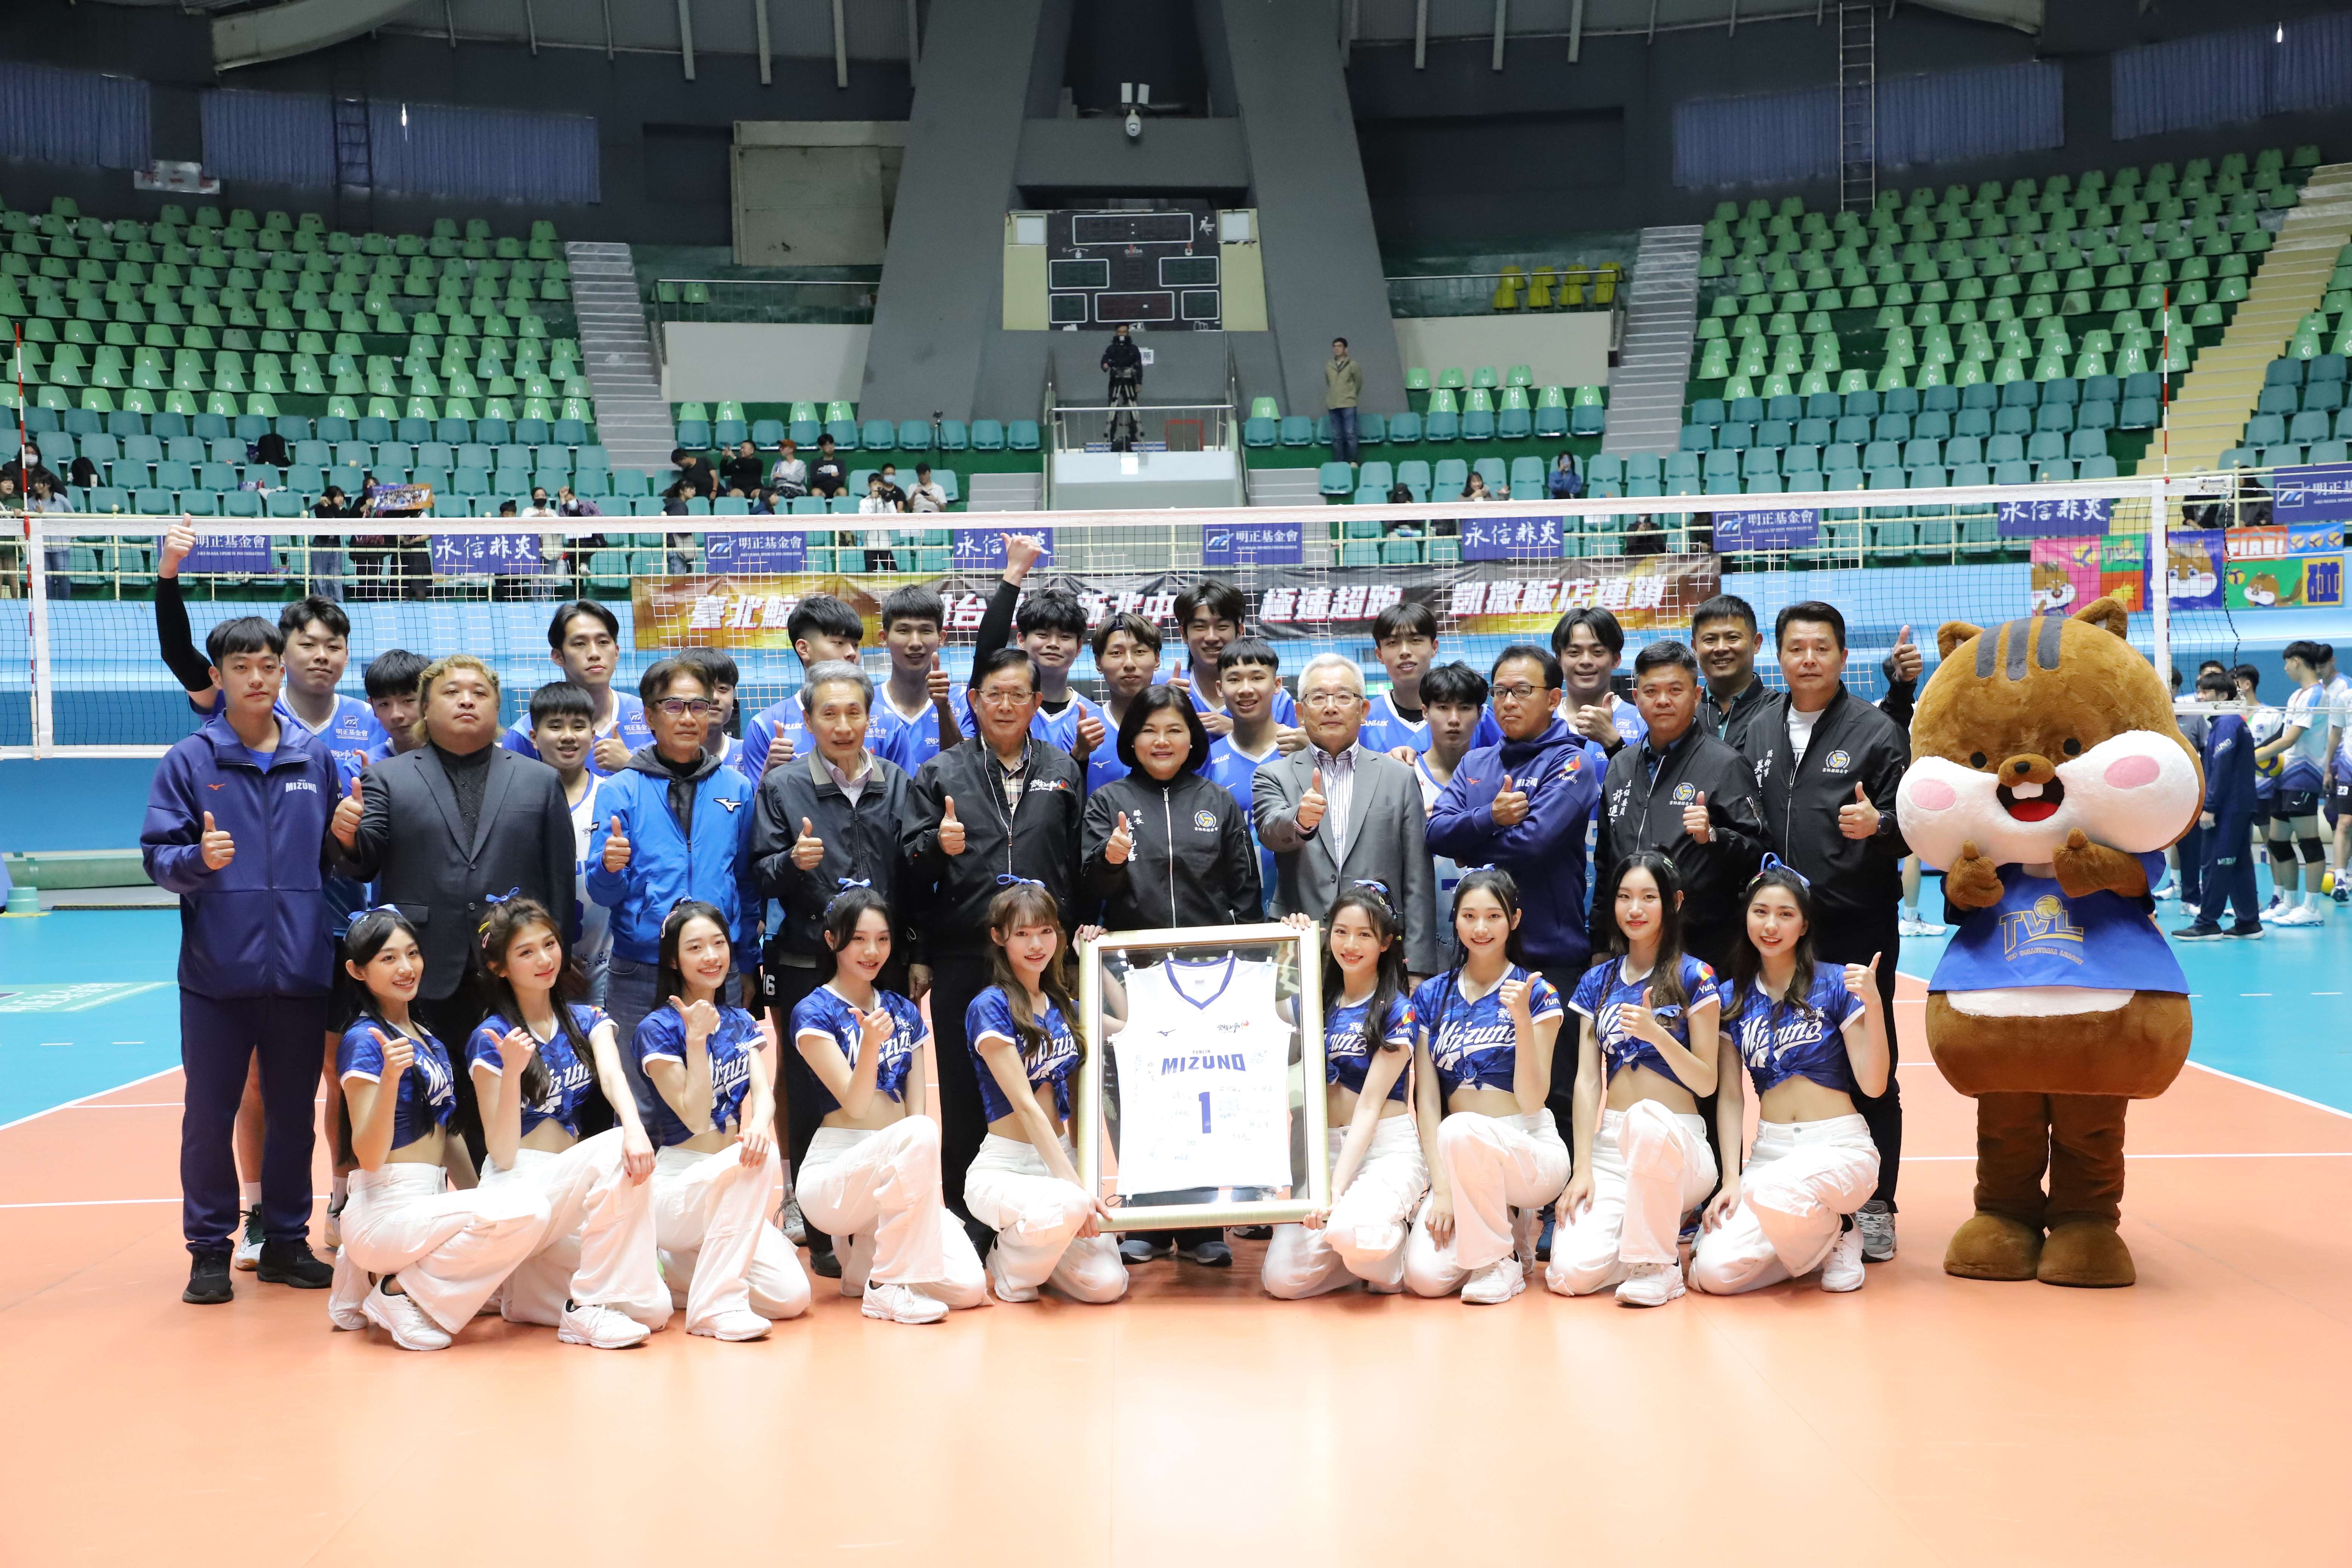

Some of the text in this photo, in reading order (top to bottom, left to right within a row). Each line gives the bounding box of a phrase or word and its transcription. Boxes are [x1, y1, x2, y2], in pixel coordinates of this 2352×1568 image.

[1748, 510, 1813, 526] 明正基金會
[195, 535, 265, 548] 明正基金會
[739, 536, 802, 549] 明正基金會
[1236, 529, 1298, 543] 明正基金會
[2228, 538, 2284, 556] FIRE!
[1076, 591, 1178, 626] 新北中
[1259, 585, 1404, 622] 極速超跑
[335, 728, 368, 737] 明正基金會
[286, 782, 317, 793] MIZUNO
[1558, 773, 1577, 784] Yunlin
[1619, 779, 1632, 816] 主任委員
[2337, 785, 2349, 795] 23
[1999, 910, 2084, 955] TVL
[2006, 947, 2083, 965] TOP VOLLEYBALL LEAGUE
[1432, 1021, 1516, 1061] Mizuno
[1161, 1054, 1246, 1076] MIZUNO
[1199, 1092, 1212, 1134] 1
